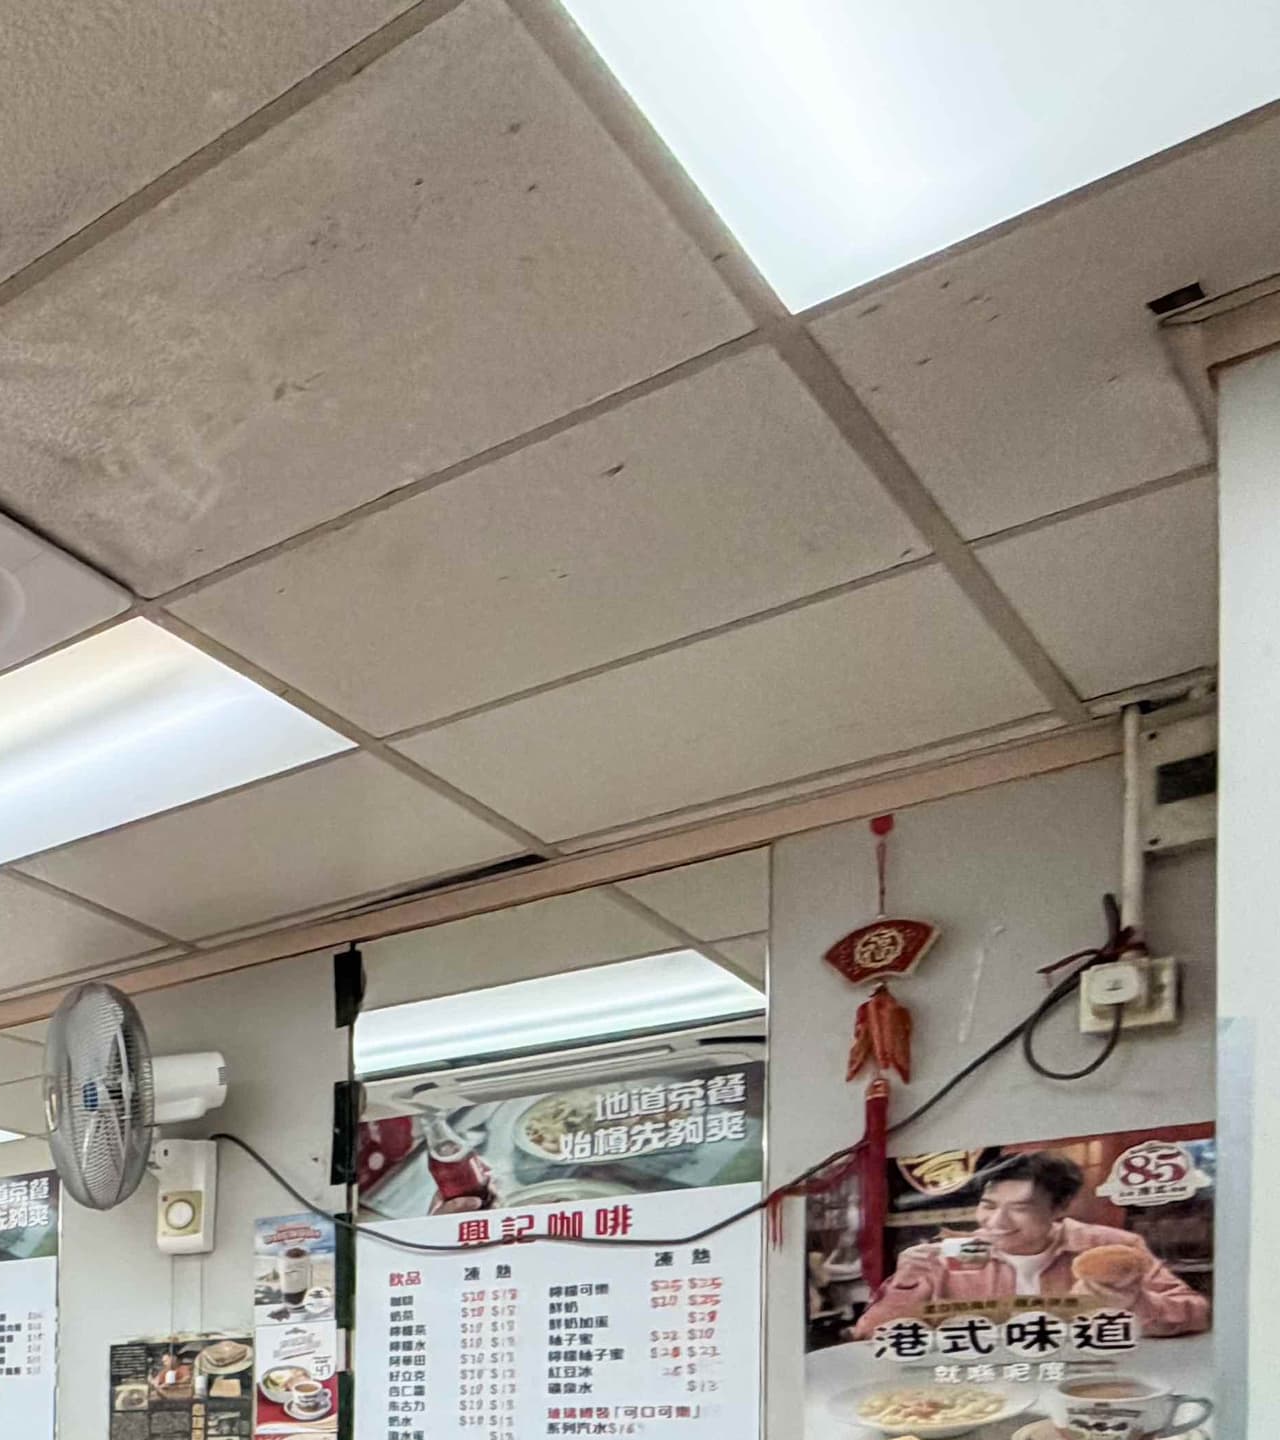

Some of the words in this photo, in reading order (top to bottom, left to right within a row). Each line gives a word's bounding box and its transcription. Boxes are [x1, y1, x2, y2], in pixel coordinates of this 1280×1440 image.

[596, 1073, 746, 1123] 地道茶餐
[1121, 1151, 1186, 1187] 85
[458, 1205, 634, 1247] 興記咖啡
[389, 1271, 421, 1286] 飲品
[549, 1301, 578, 1314] 鮮奶
[875, 1312, 1137, 1359] 港式味道
[548, 1366, 593, 1379] 紅豆冰
